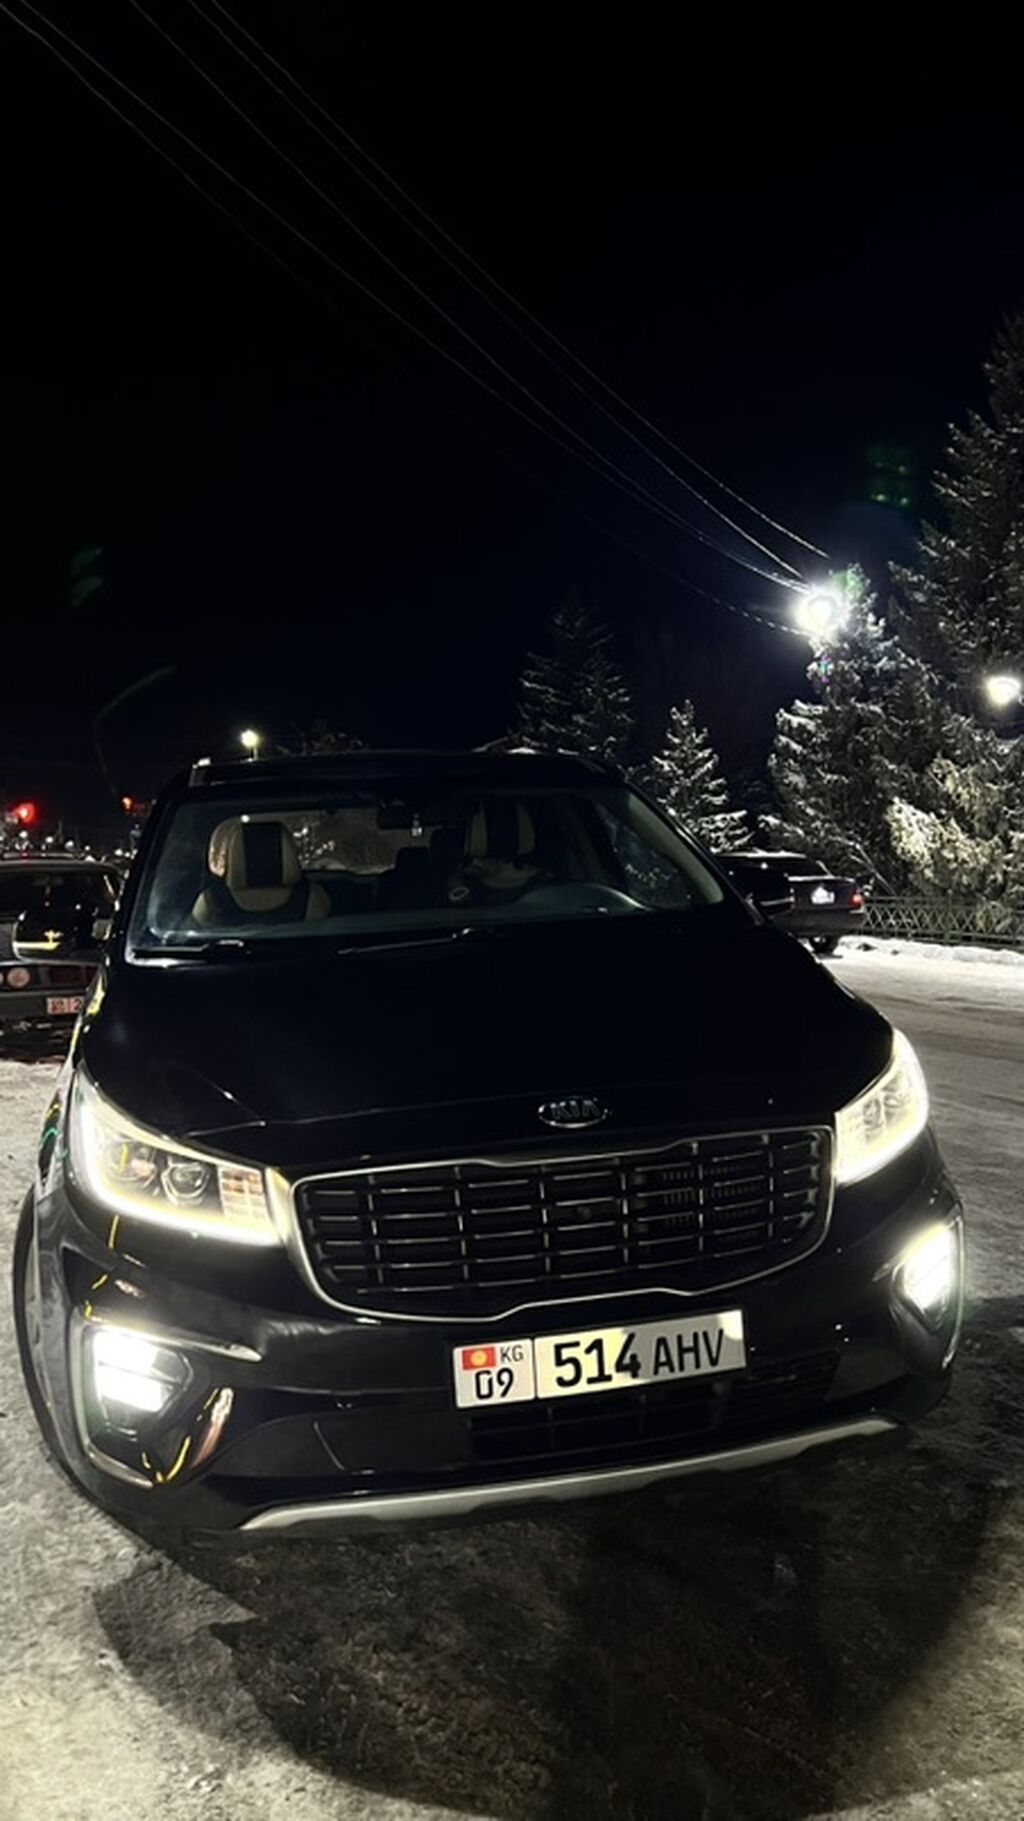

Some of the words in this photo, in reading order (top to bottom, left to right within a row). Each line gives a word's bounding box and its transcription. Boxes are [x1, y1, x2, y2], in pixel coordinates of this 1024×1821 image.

[500, 1345, 524, 1364] KG
[553, 1332, 642, 1388] 514
[653, 1328, 724, 1376] AHV
[474, 1367, 514, 1400] 09
